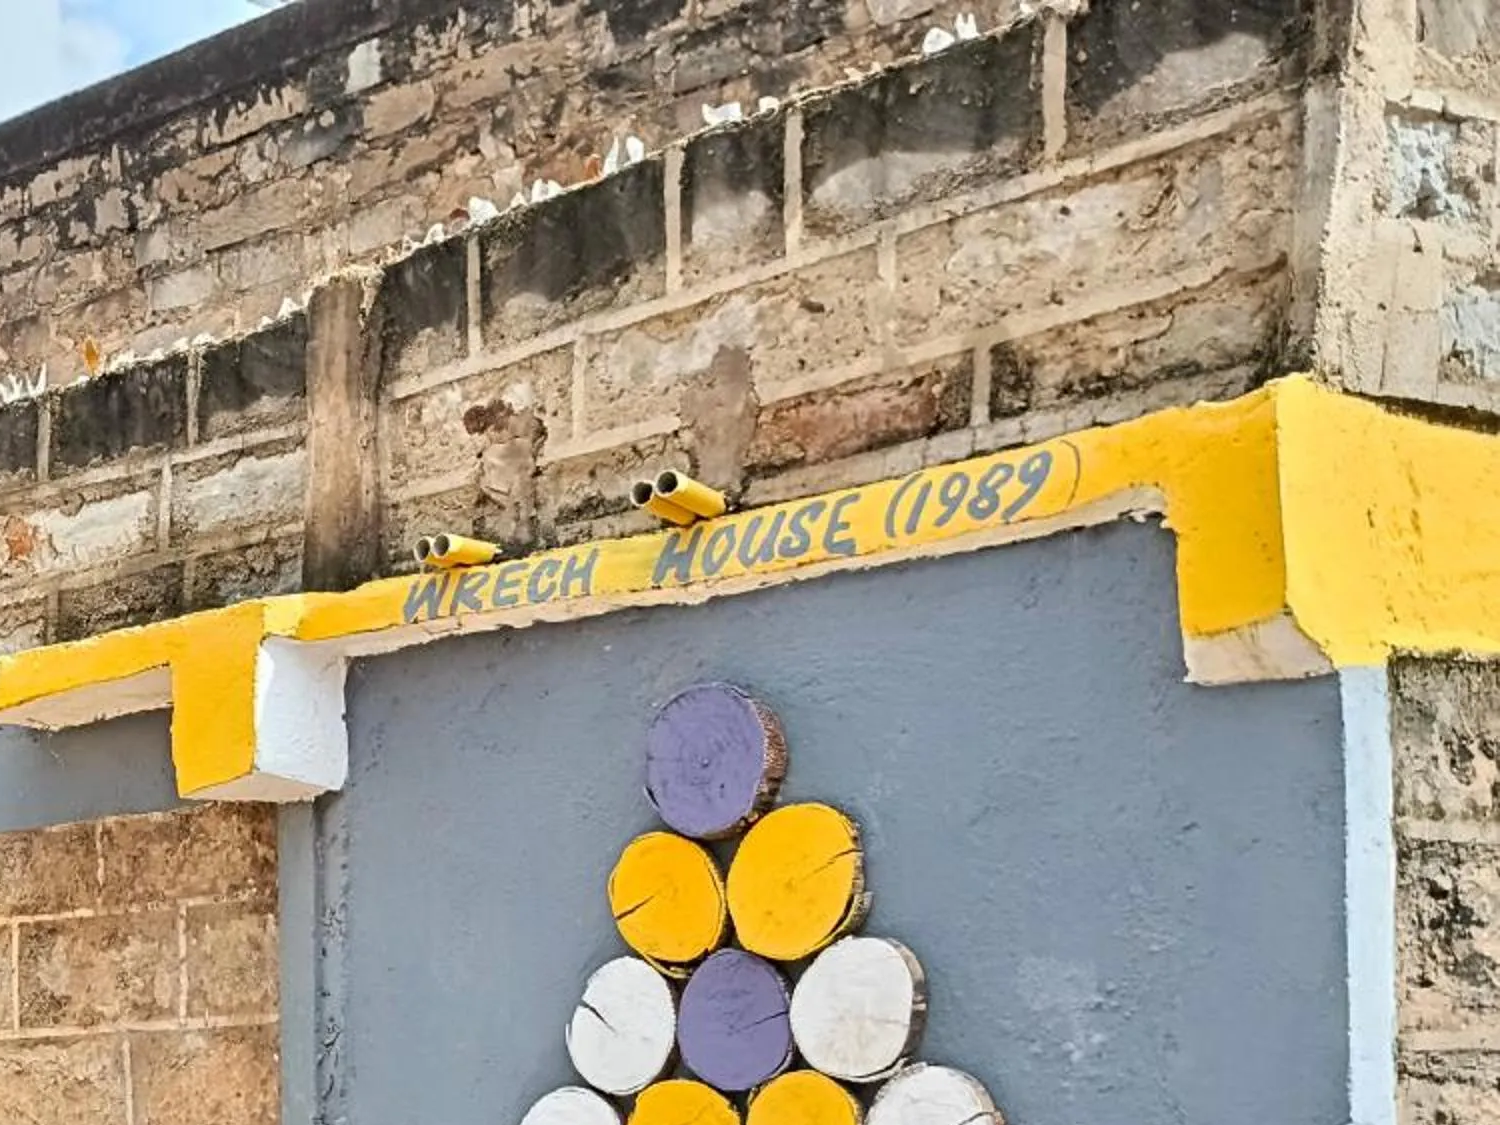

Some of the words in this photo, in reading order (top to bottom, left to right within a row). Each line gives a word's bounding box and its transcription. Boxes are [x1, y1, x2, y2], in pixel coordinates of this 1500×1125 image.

[403, 550, 594, 623] WRECH
[654, 493, 861, 584] HOUSE
[885, 438, 1081, 538] (1989)
